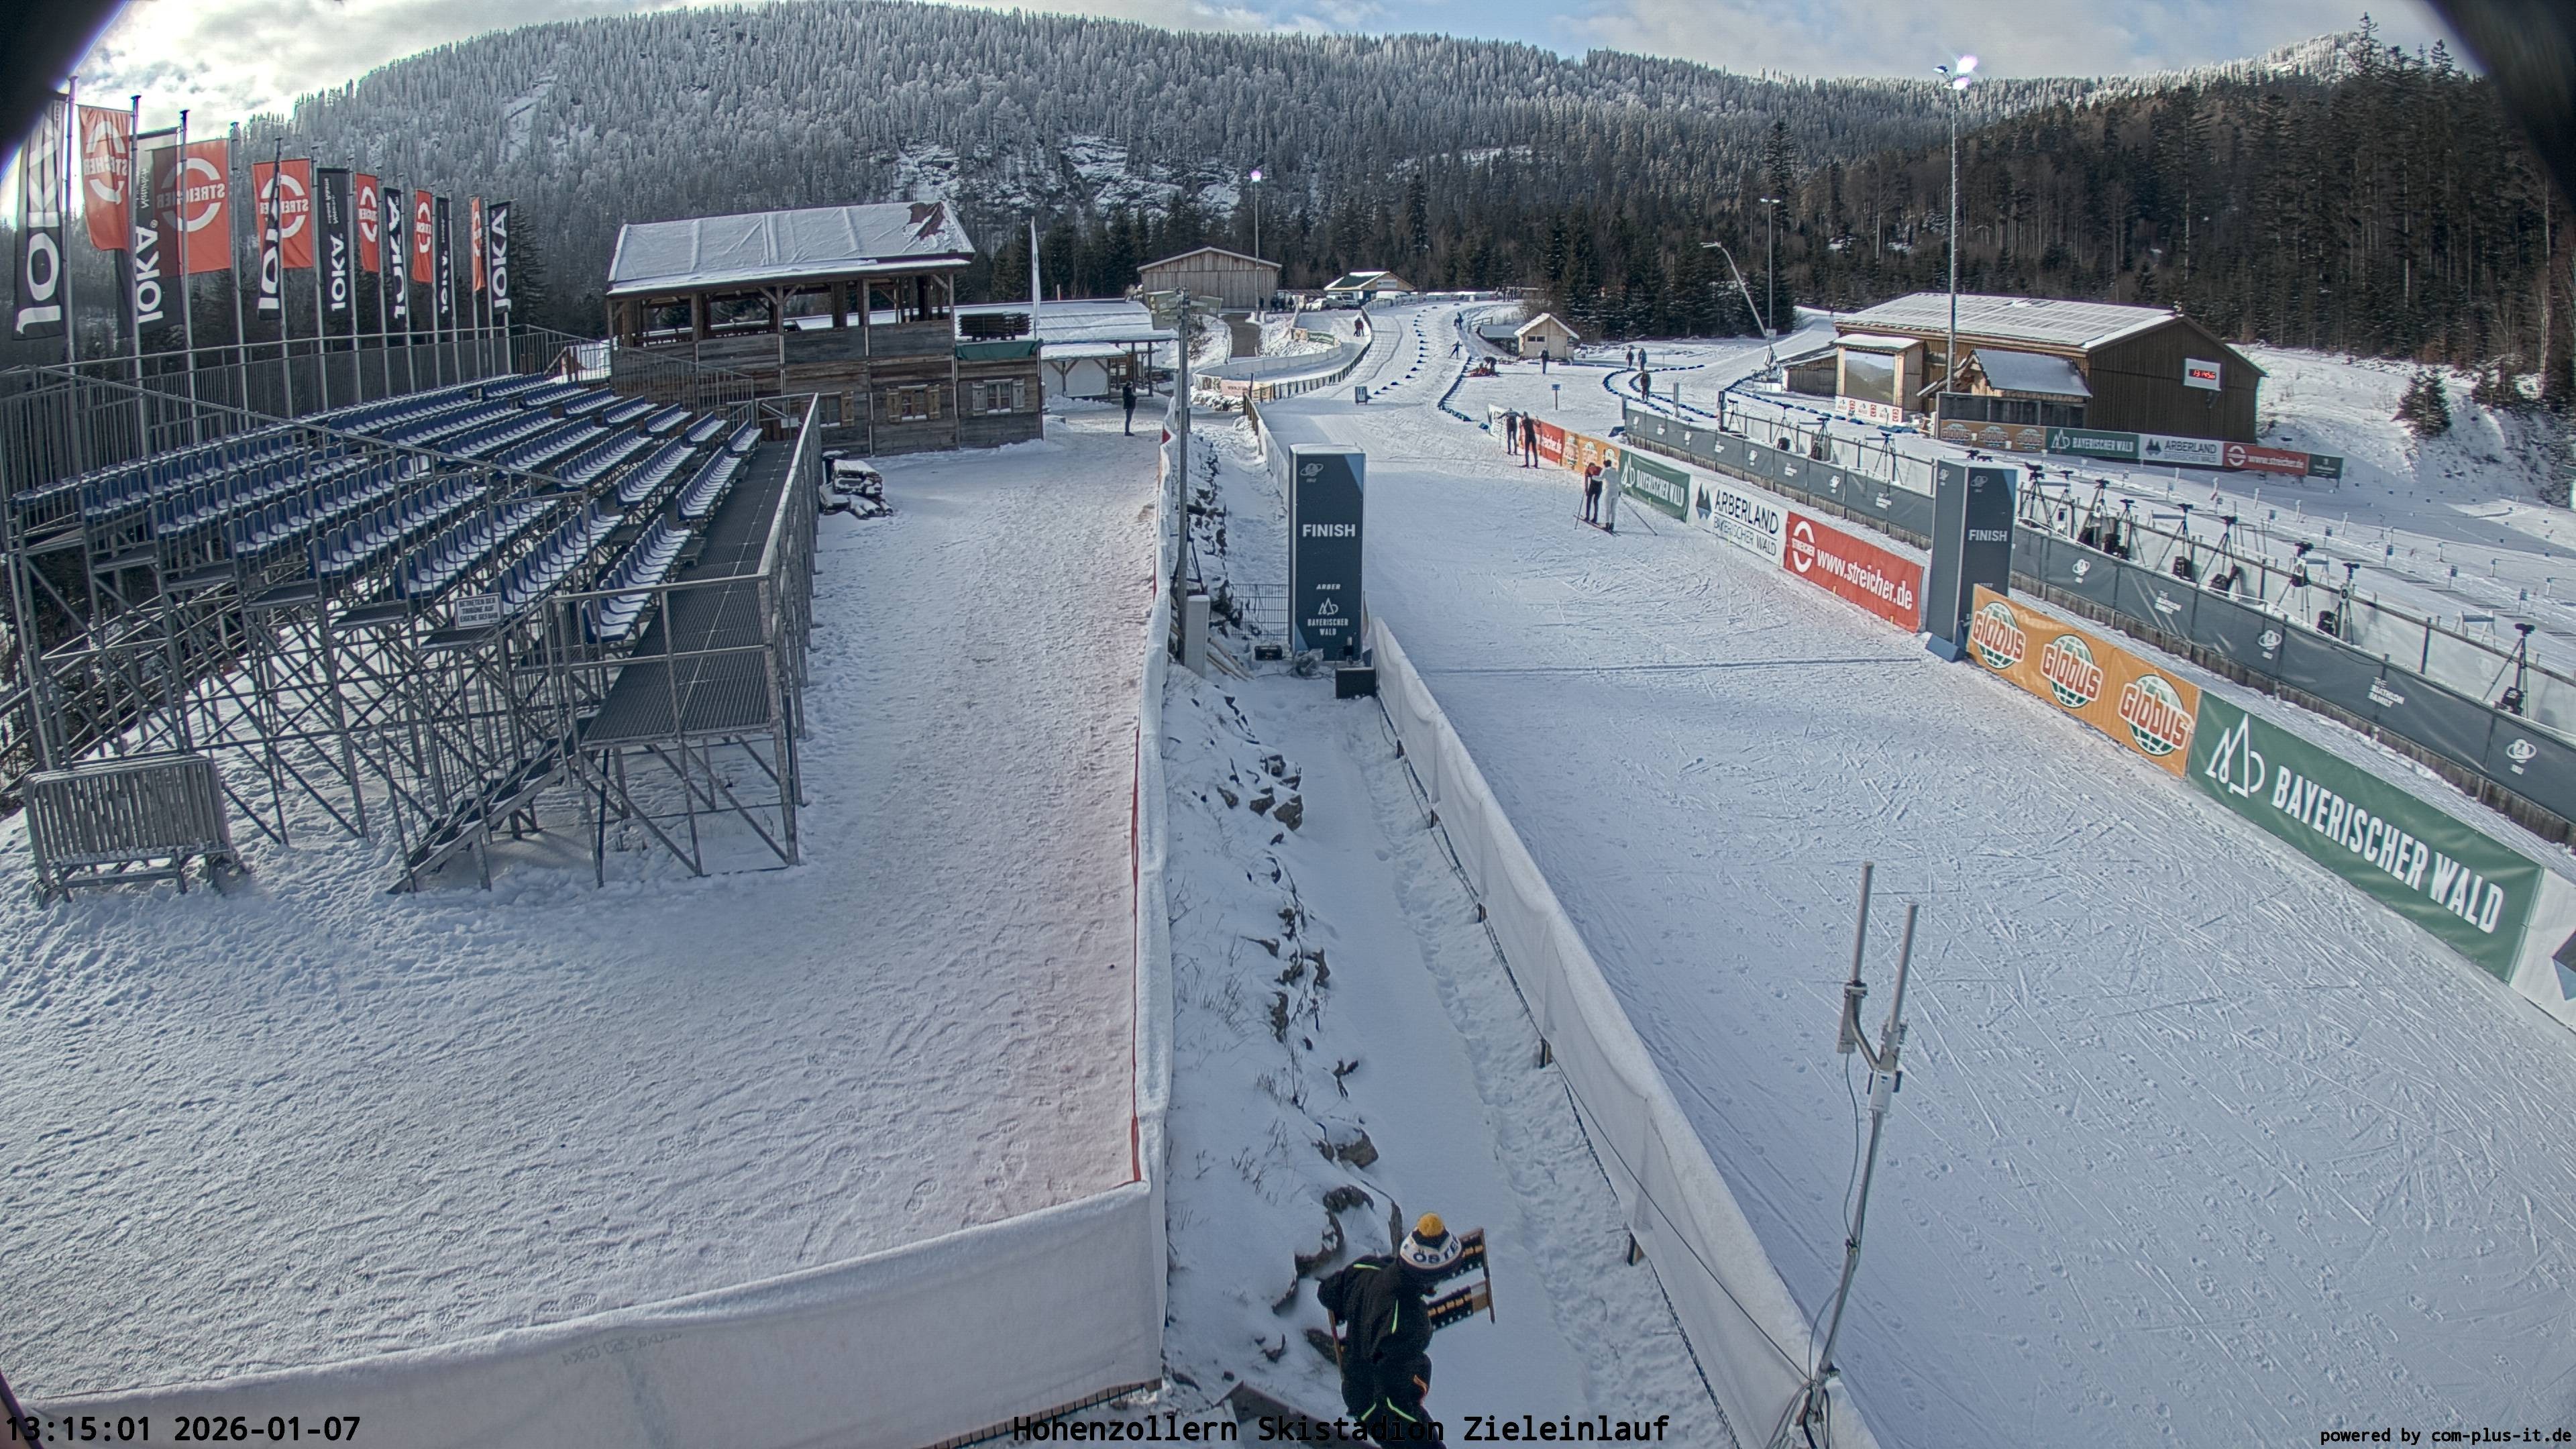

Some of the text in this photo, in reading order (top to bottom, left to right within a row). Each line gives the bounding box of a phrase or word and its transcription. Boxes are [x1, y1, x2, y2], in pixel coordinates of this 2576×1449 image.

[492, 208, 512, 311] JOKA
[2072, 437, 2134, 452] BAYERISCHER WALD
[2164, 440, 2217, 454] ARBERLAND
[1637, 470, 1684, 507] BAYERISCHER WALD
[1715, 489, 1779, 534] ARBERLAND
[1302, 524, 1356, 537] FINISH
[1713, 516, 1754, 546] BAYERISCHER
[1756, 535, 1777, 557] WALD
[1968, 529, 2008, 542] FINISH
[1817, 549, 1913, 610] www.streicher.de
[1307, 618, 1349, 627] BAYERISCHER
[1319, 628, 1337, 636] WALD
[2271, 765, 2504, 934] BAYERISCHER WALD
